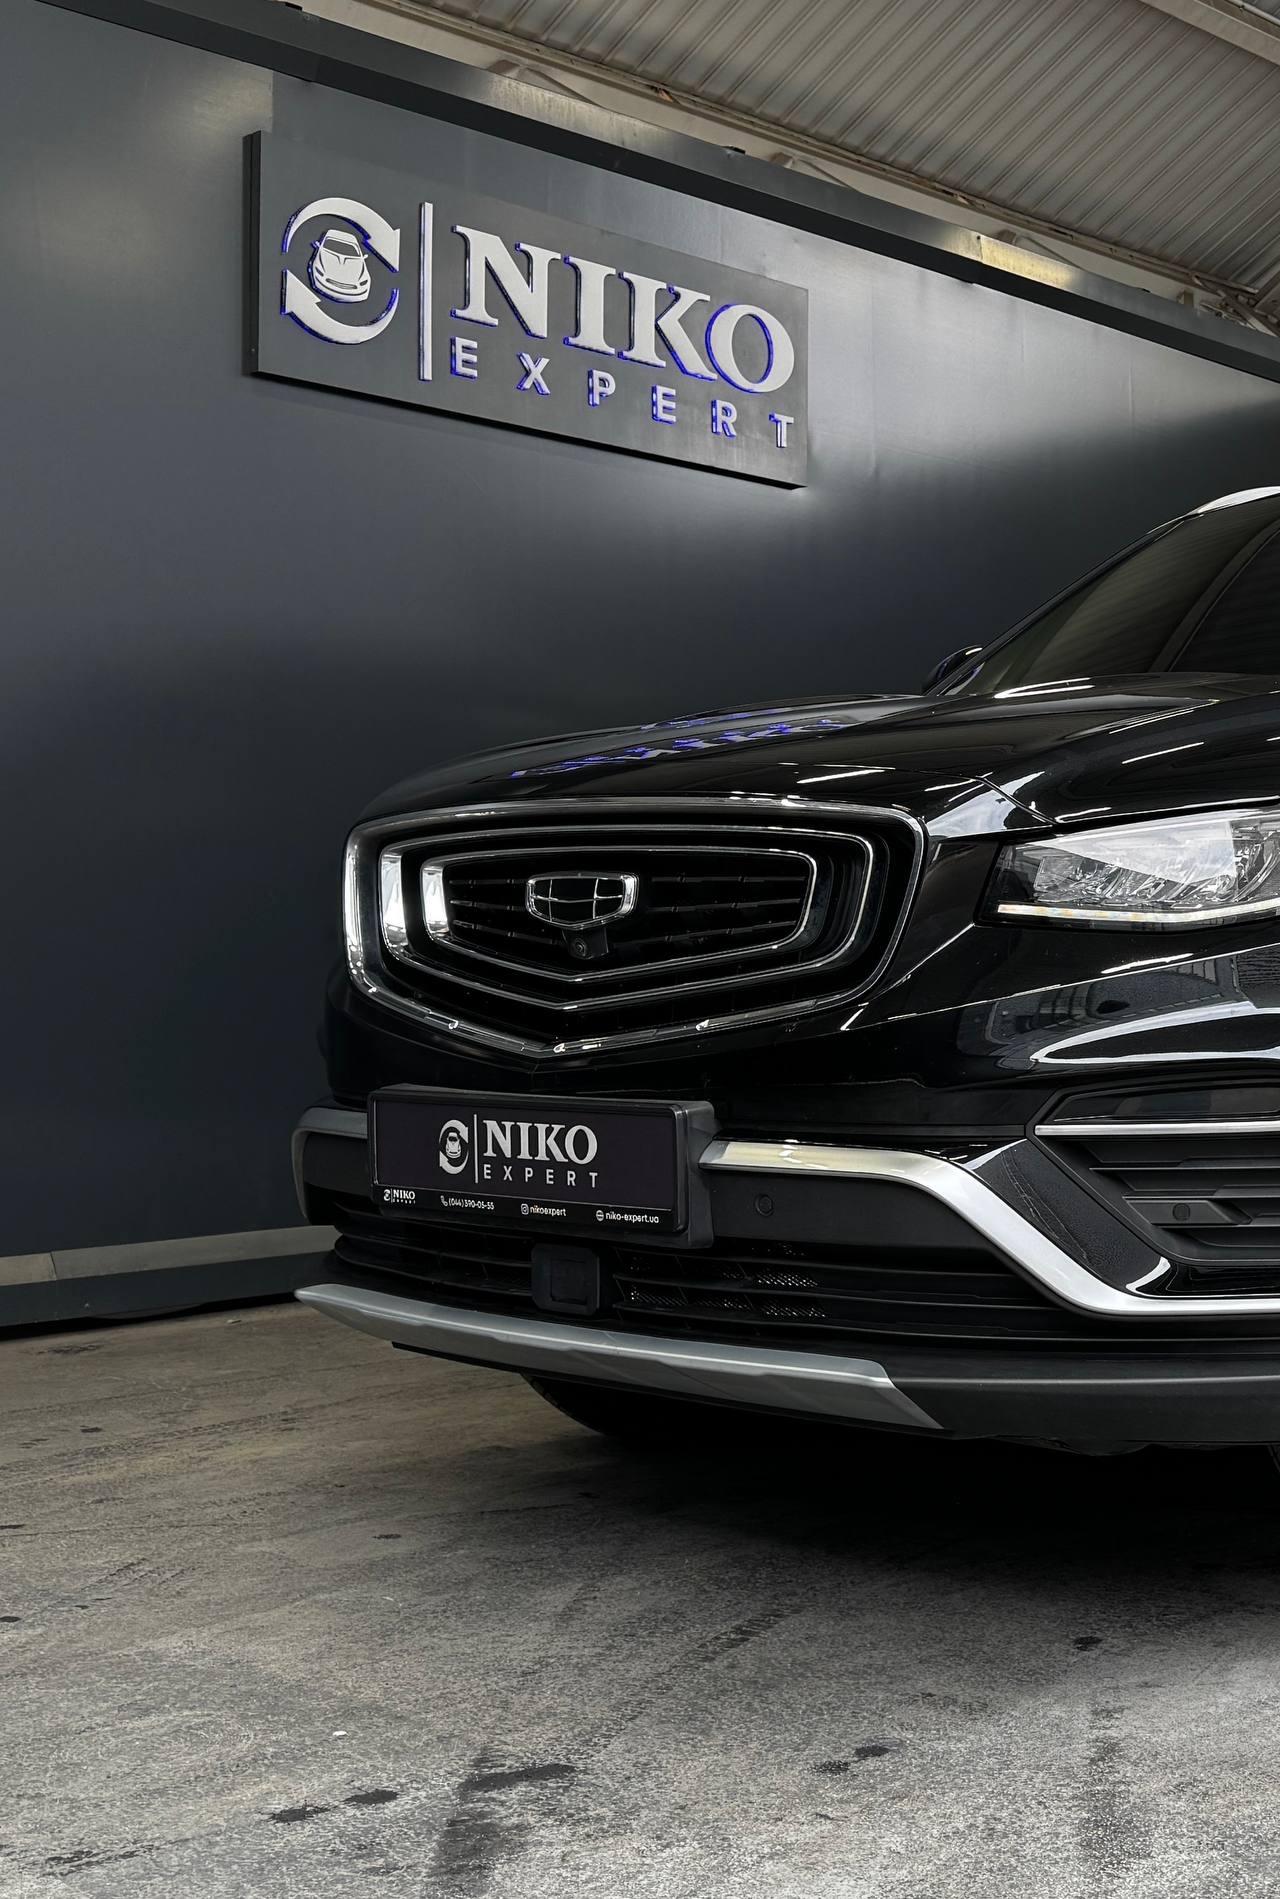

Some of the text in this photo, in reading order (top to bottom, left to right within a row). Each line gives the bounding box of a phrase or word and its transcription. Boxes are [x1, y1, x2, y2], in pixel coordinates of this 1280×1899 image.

[450, 225, 795, 394] NIKO
[450, 336, 795, 449] EXPERT
[483, 1119, 598, 1165] NIKO
[483, 1164, 598, 1188] EXPERT
[393, 1187, 415, 1200] NIKO
[529, 1204, 566, 1217] nikoexpert
[605, 1210, 659, 1224] niko-expert.ua
